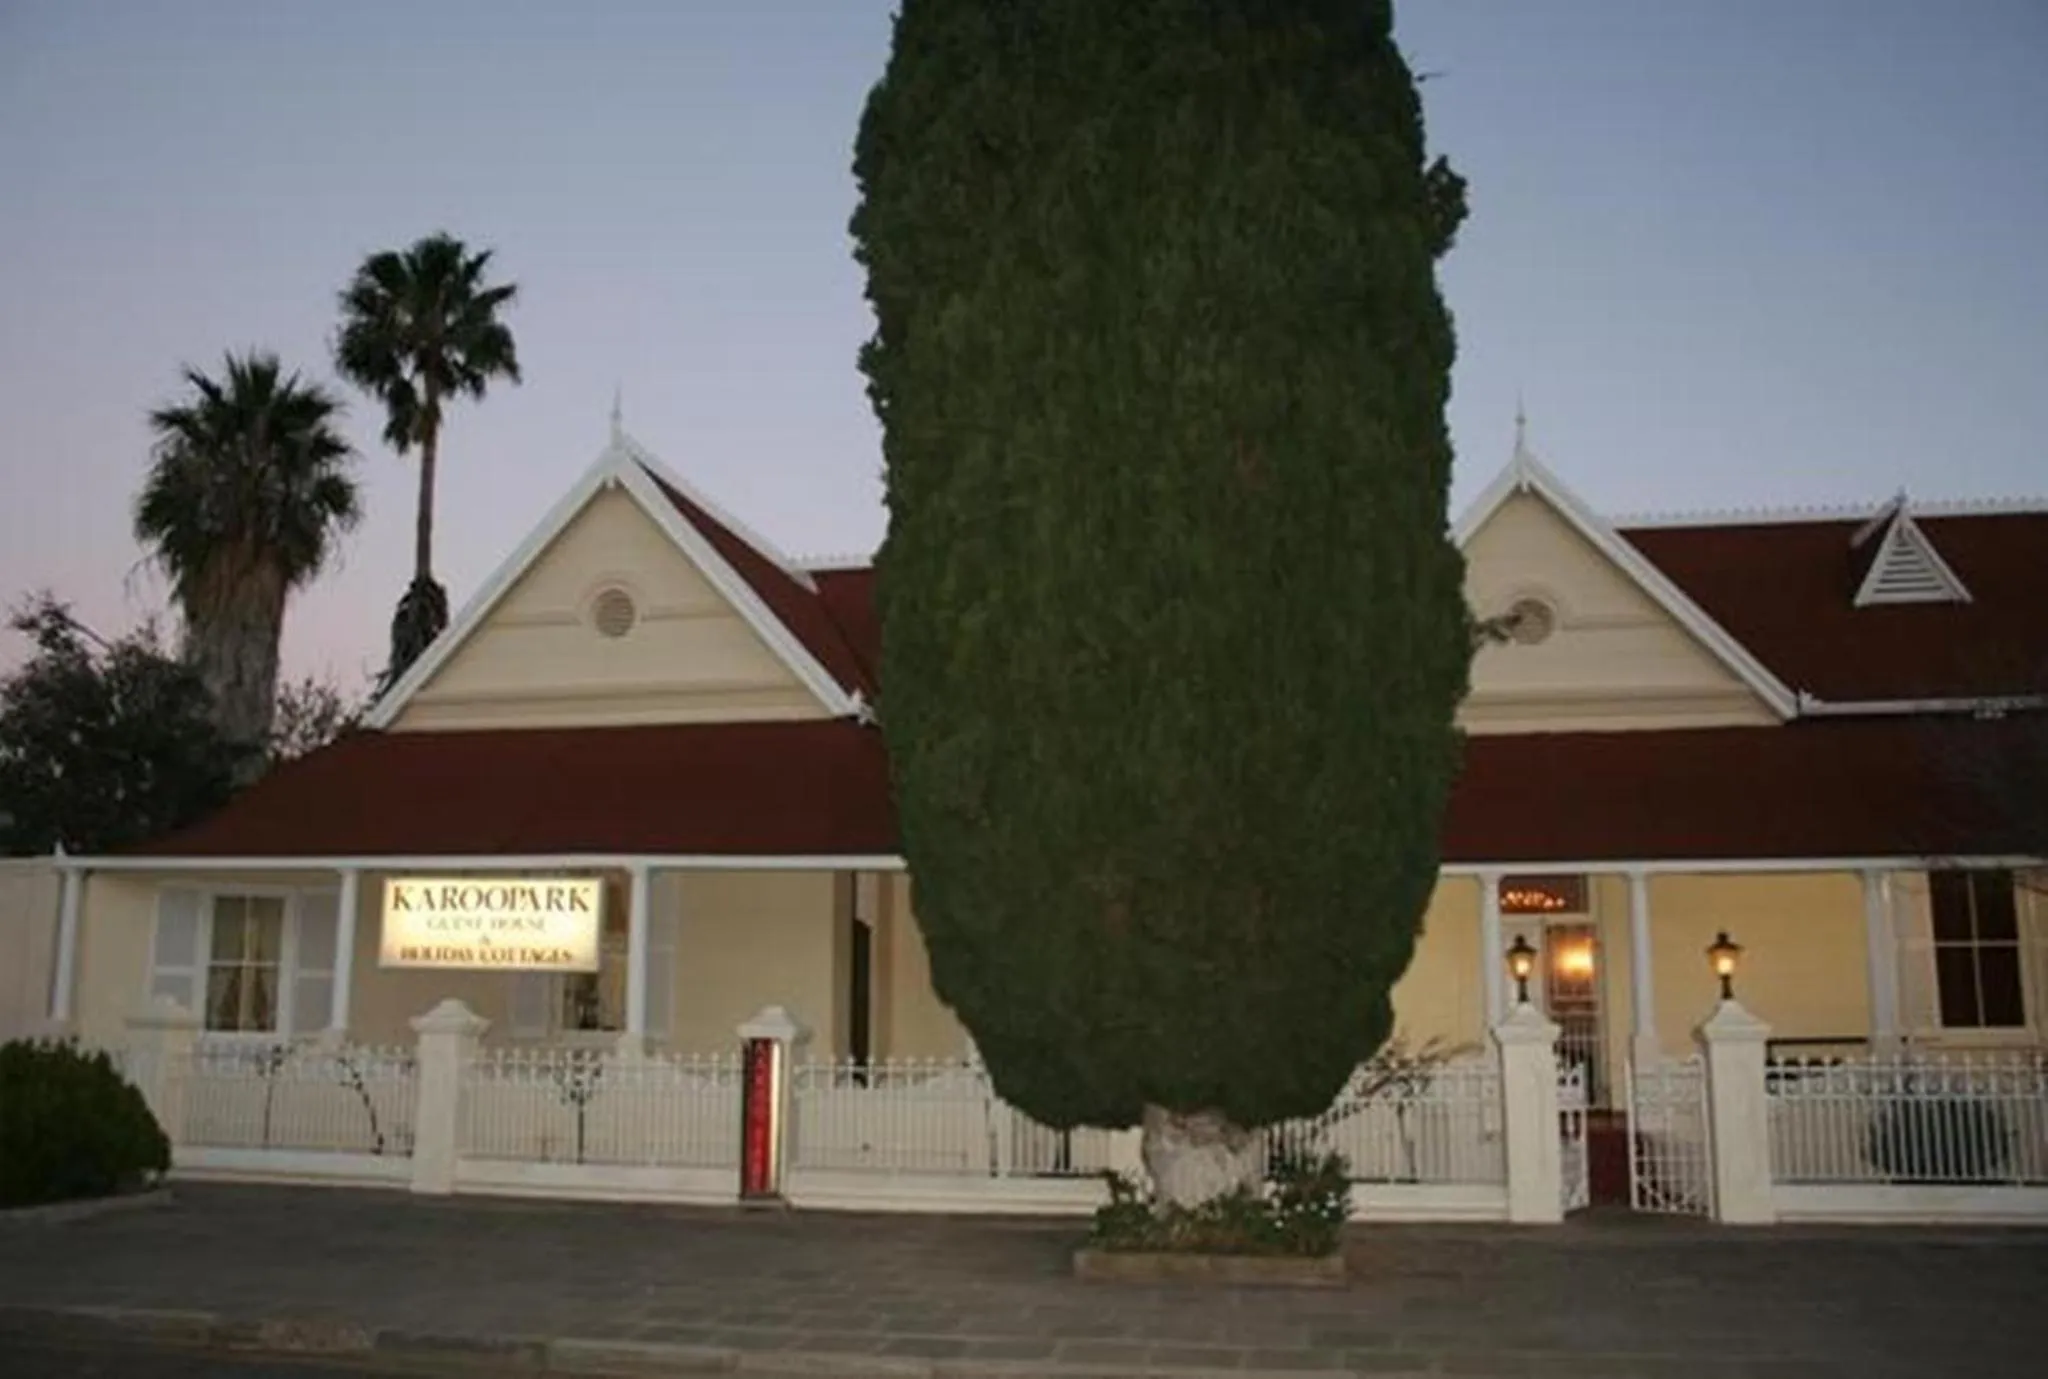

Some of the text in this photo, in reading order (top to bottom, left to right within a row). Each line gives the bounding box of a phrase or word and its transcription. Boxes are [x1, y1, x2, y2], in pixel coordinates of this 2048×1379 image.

[392, 885, 591, 912] KAROOPARK
[400, 947, 573, 963] HOLIDAY COTTAGES
